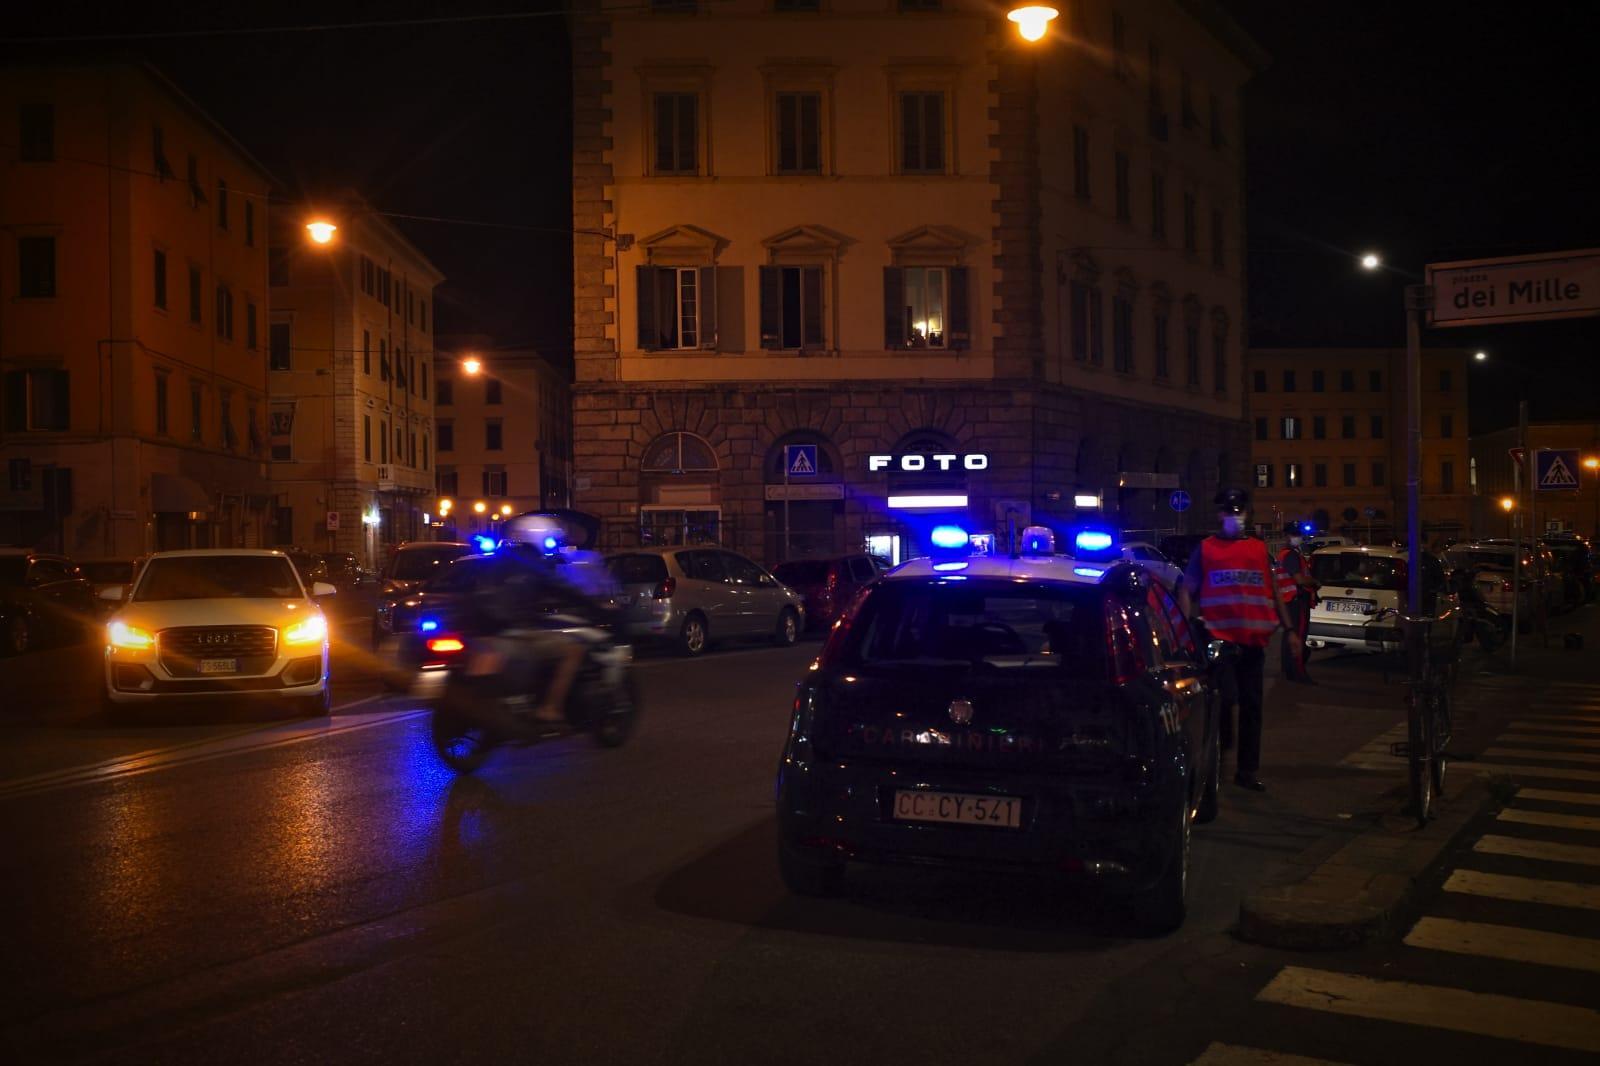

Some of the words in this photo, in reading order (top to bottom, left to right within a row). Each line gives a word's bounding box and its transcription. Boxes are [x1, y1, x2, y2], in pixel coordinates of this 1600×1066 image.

[1454, 285, 1495, 309] dei
[1509, 278, 1580, 304] Mille
[869, 454, 988, 471] FOTO
[863, 726, 1044, 752] CARINIRI
